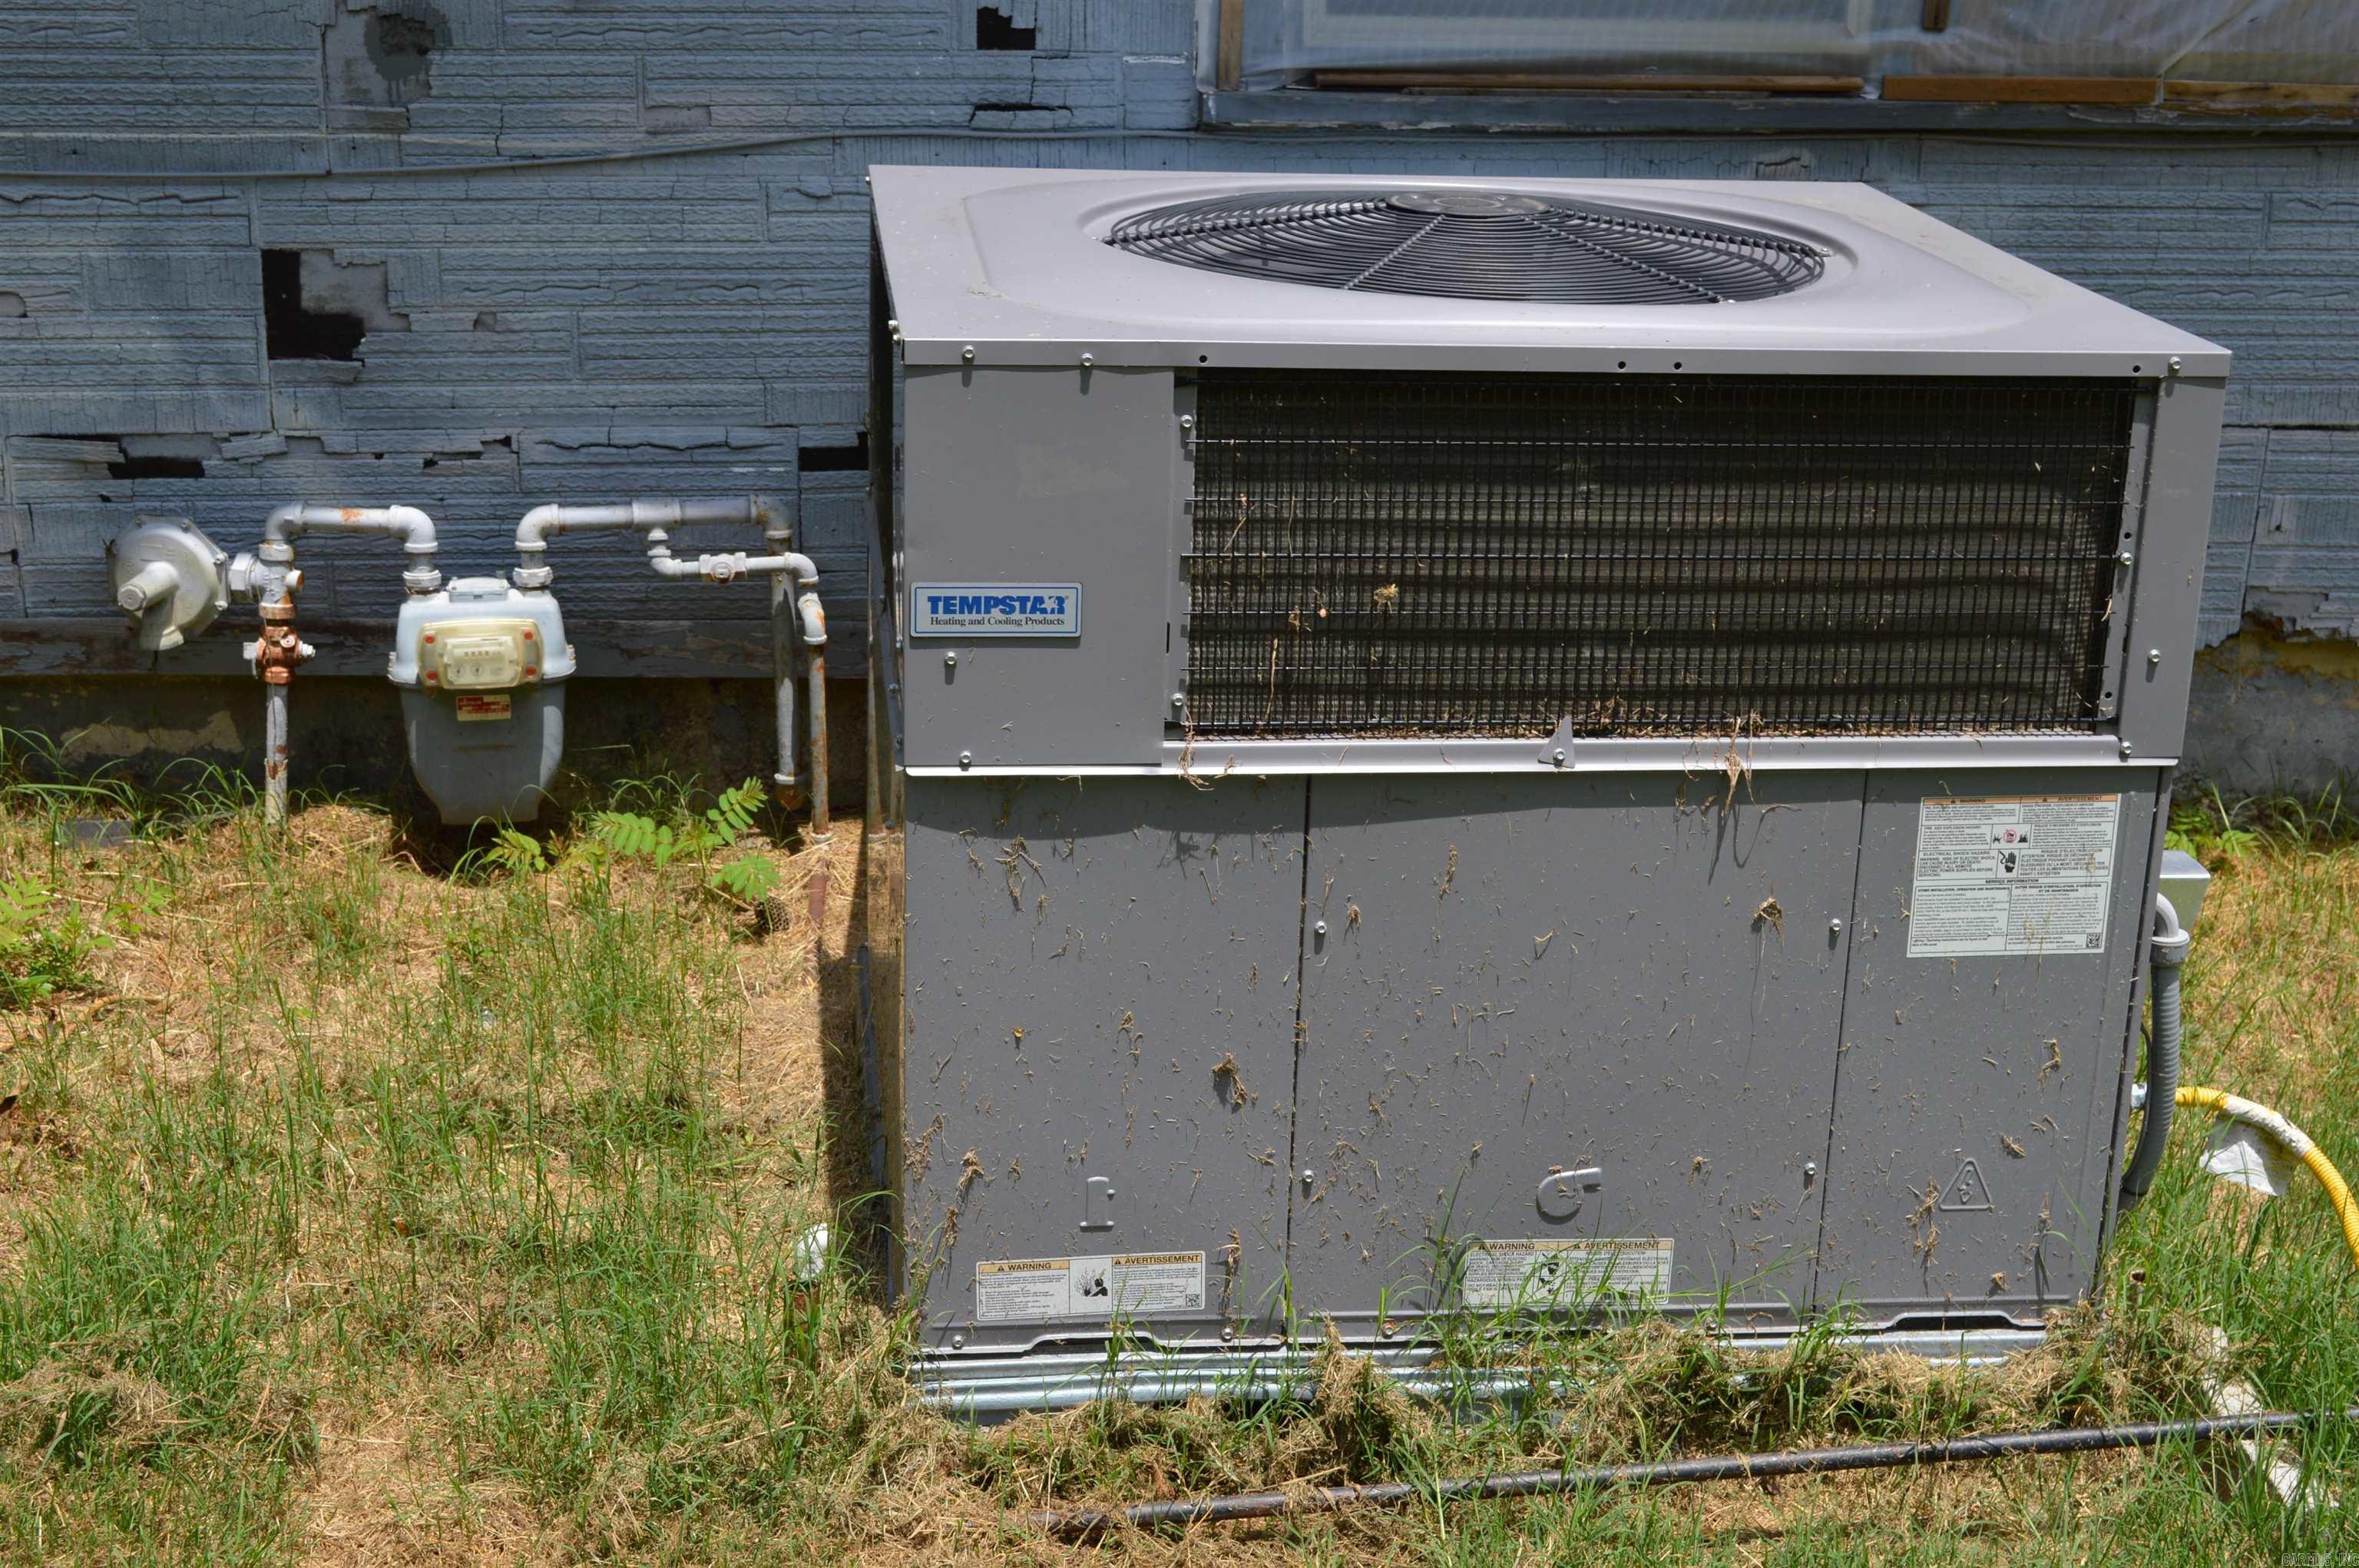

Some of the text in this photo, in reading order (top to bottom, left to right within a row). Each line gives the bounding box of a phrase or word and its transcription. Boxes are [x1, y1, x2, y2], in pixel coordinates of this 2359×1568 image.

[927, 596, 1066, 615] TEMPSTAR
[930, 617, 1065, 627] Heating and Cooling Products
[1124, 1255, 1199, 1265] AVERTISSEMENT
[1007, 1262, 1051, 1271] WARNING
